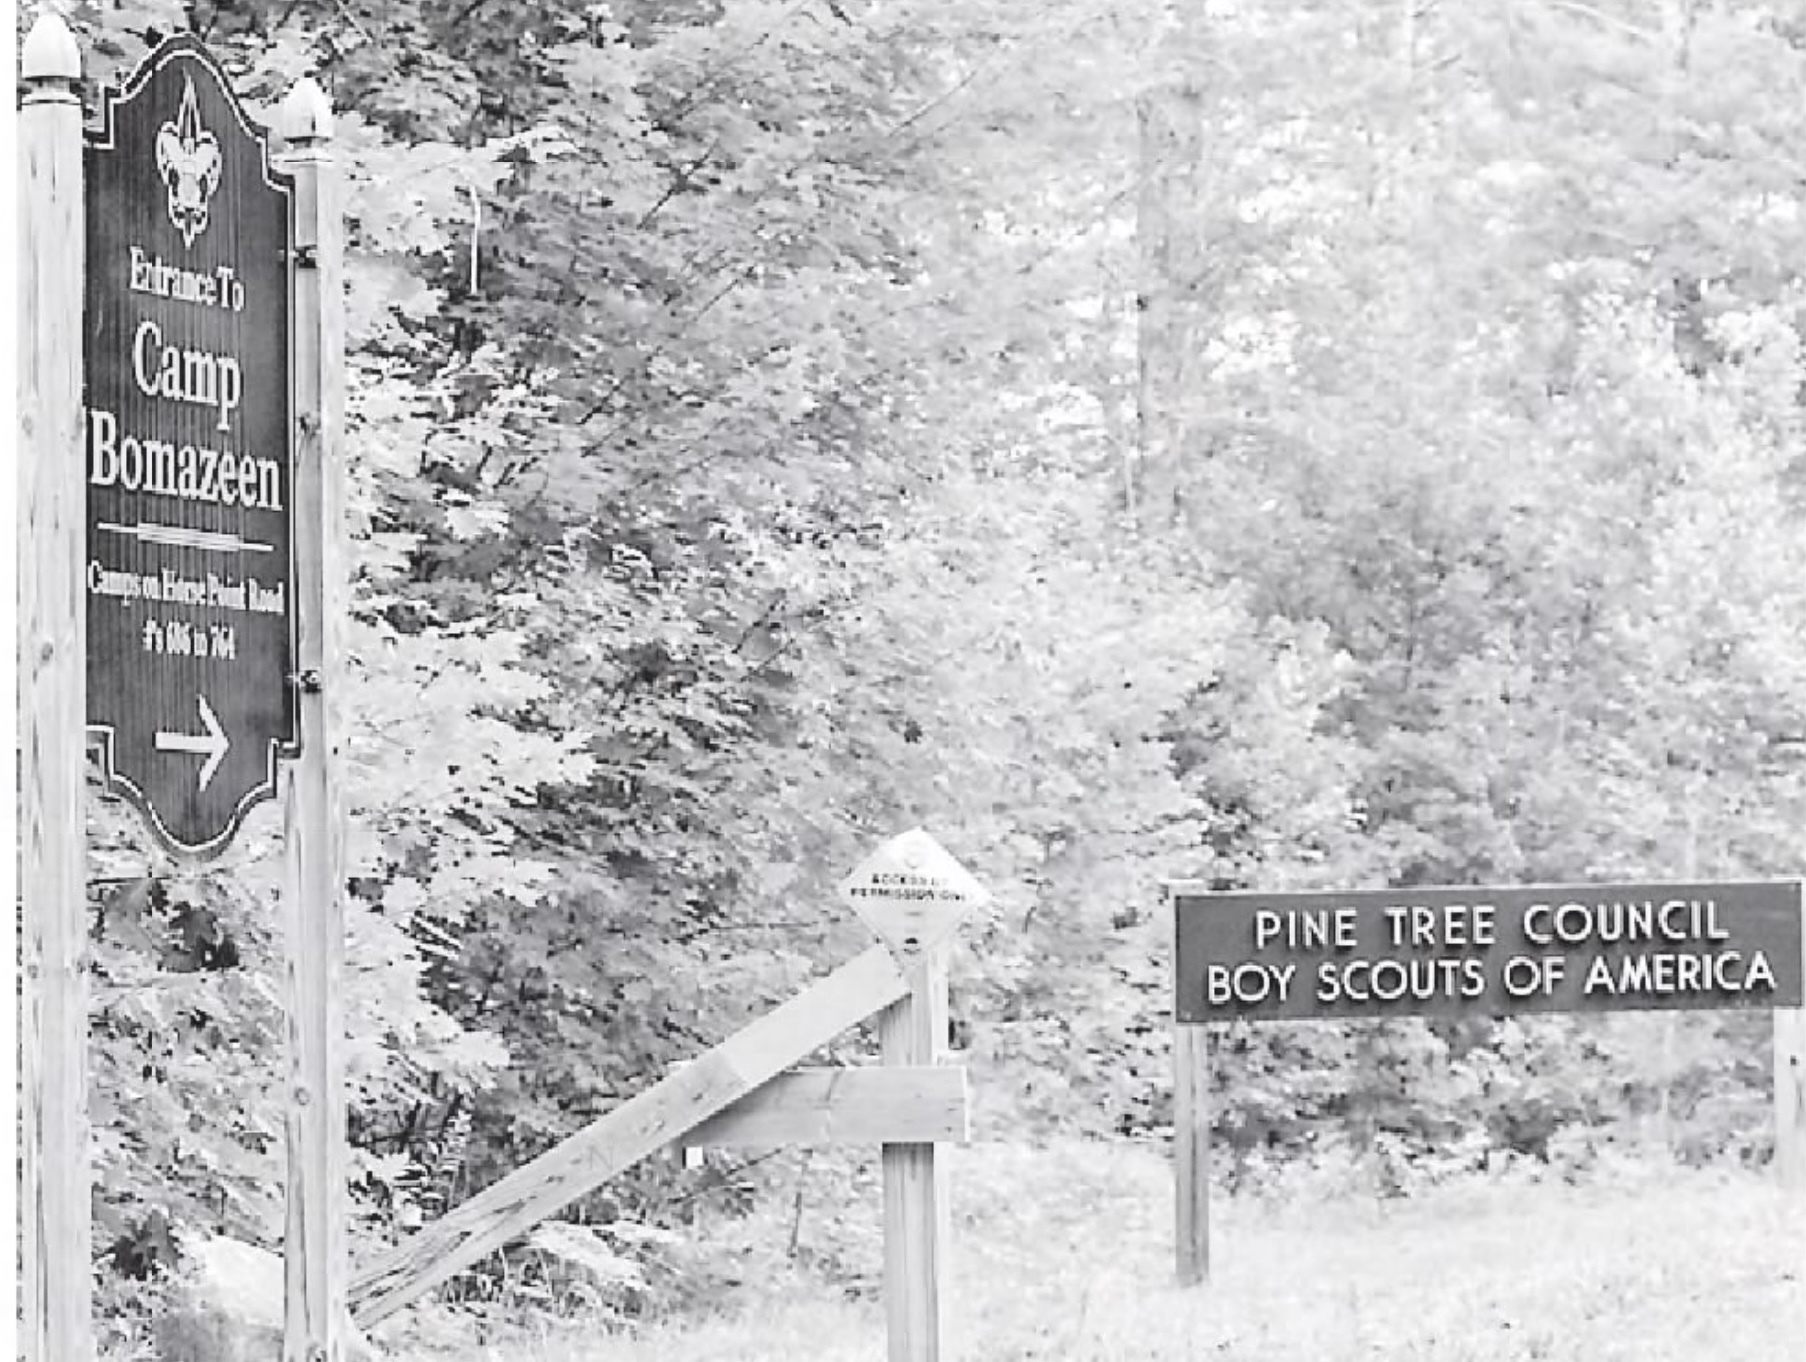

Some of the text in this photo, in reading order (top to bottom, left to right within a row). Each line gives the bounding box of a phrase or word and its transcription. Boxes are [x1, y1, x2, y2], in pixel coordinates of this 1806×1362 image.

[130, 246, 245, 312] Entrance To
[134, 320, 241, 431] Camp
[90, 410, 284, 511] Bomazeen
[1256, 899, 1730, 949] PINE TREE COUNCIL
[1208, 950, 1777, 1005] BOY SCOUTS OF AMERICA
